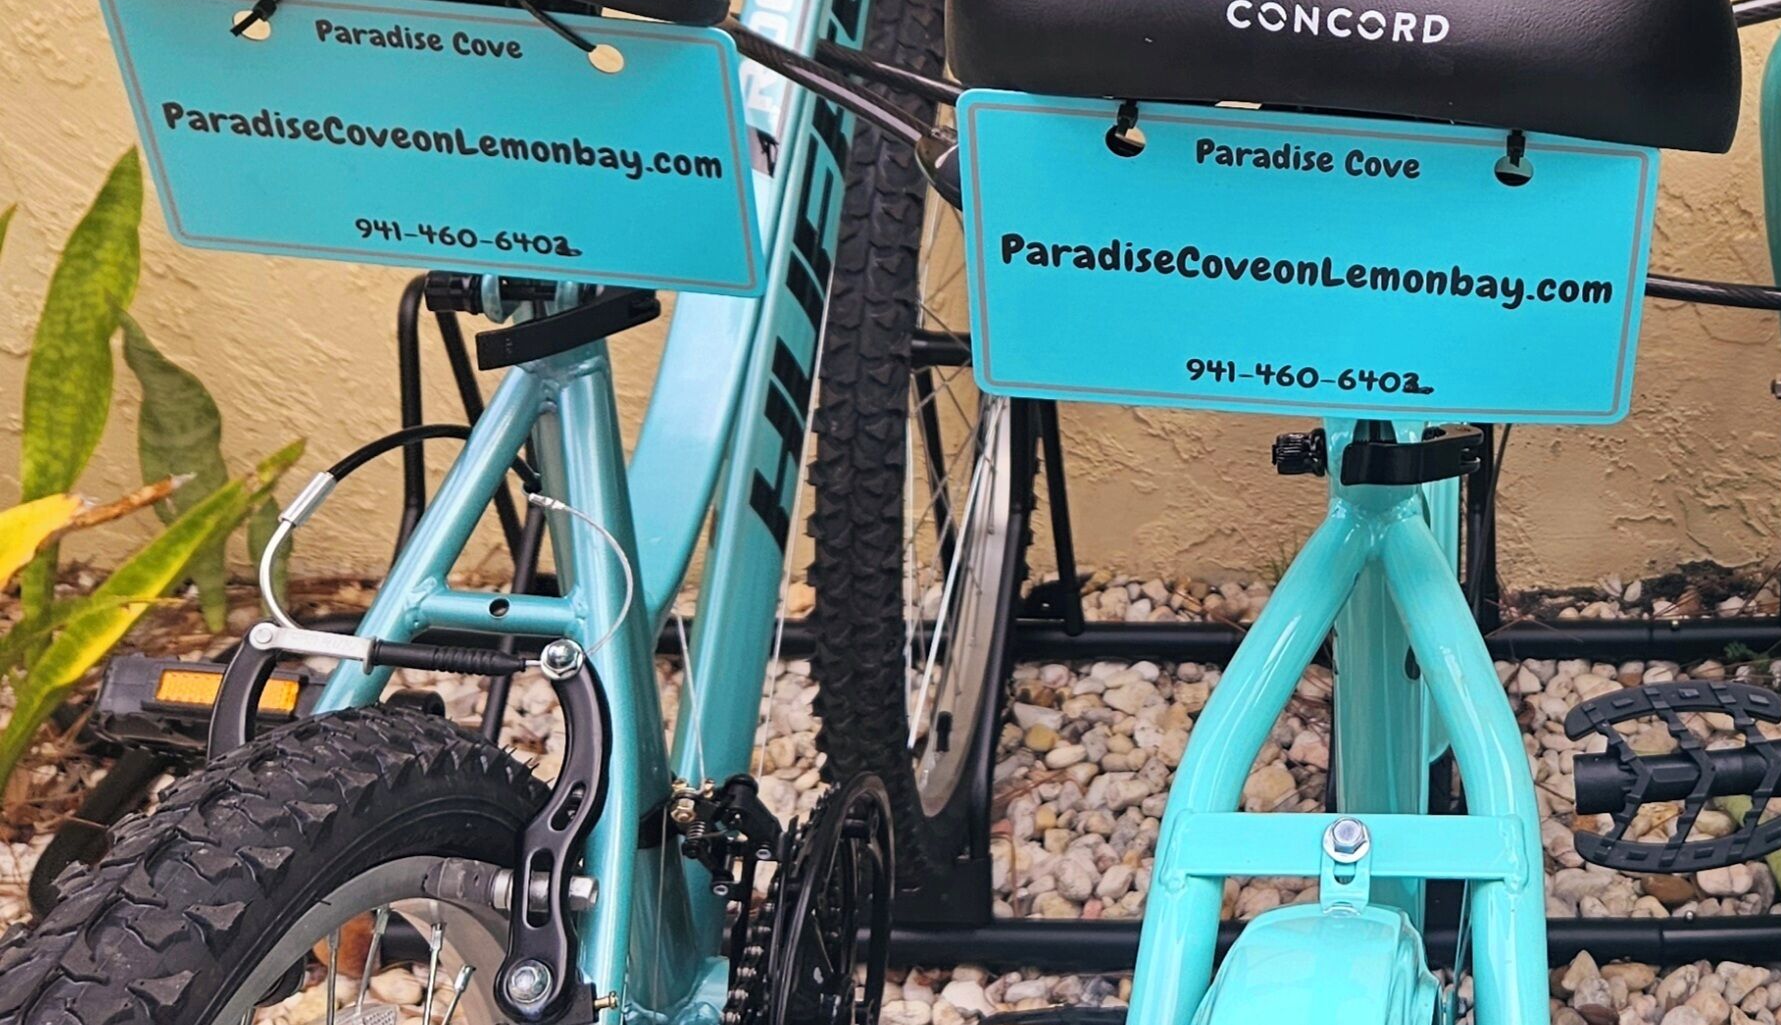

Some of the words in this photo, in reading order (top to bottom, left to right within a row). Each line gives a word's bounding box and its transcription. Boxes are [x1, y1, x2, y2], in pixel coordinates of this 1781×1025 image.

[315, 20, 443, 51] Paradise
[453, 32, 522, 58] Cove
[163, 102, 721, 179] ParadiseCoveonLemonbay.com
[1197, 139, 1333, 172] Paradise
[1345, 150, 1419, 178] Cove
[1002, 234, 1612, 309] ParadiseCoveonLemonbay.com
